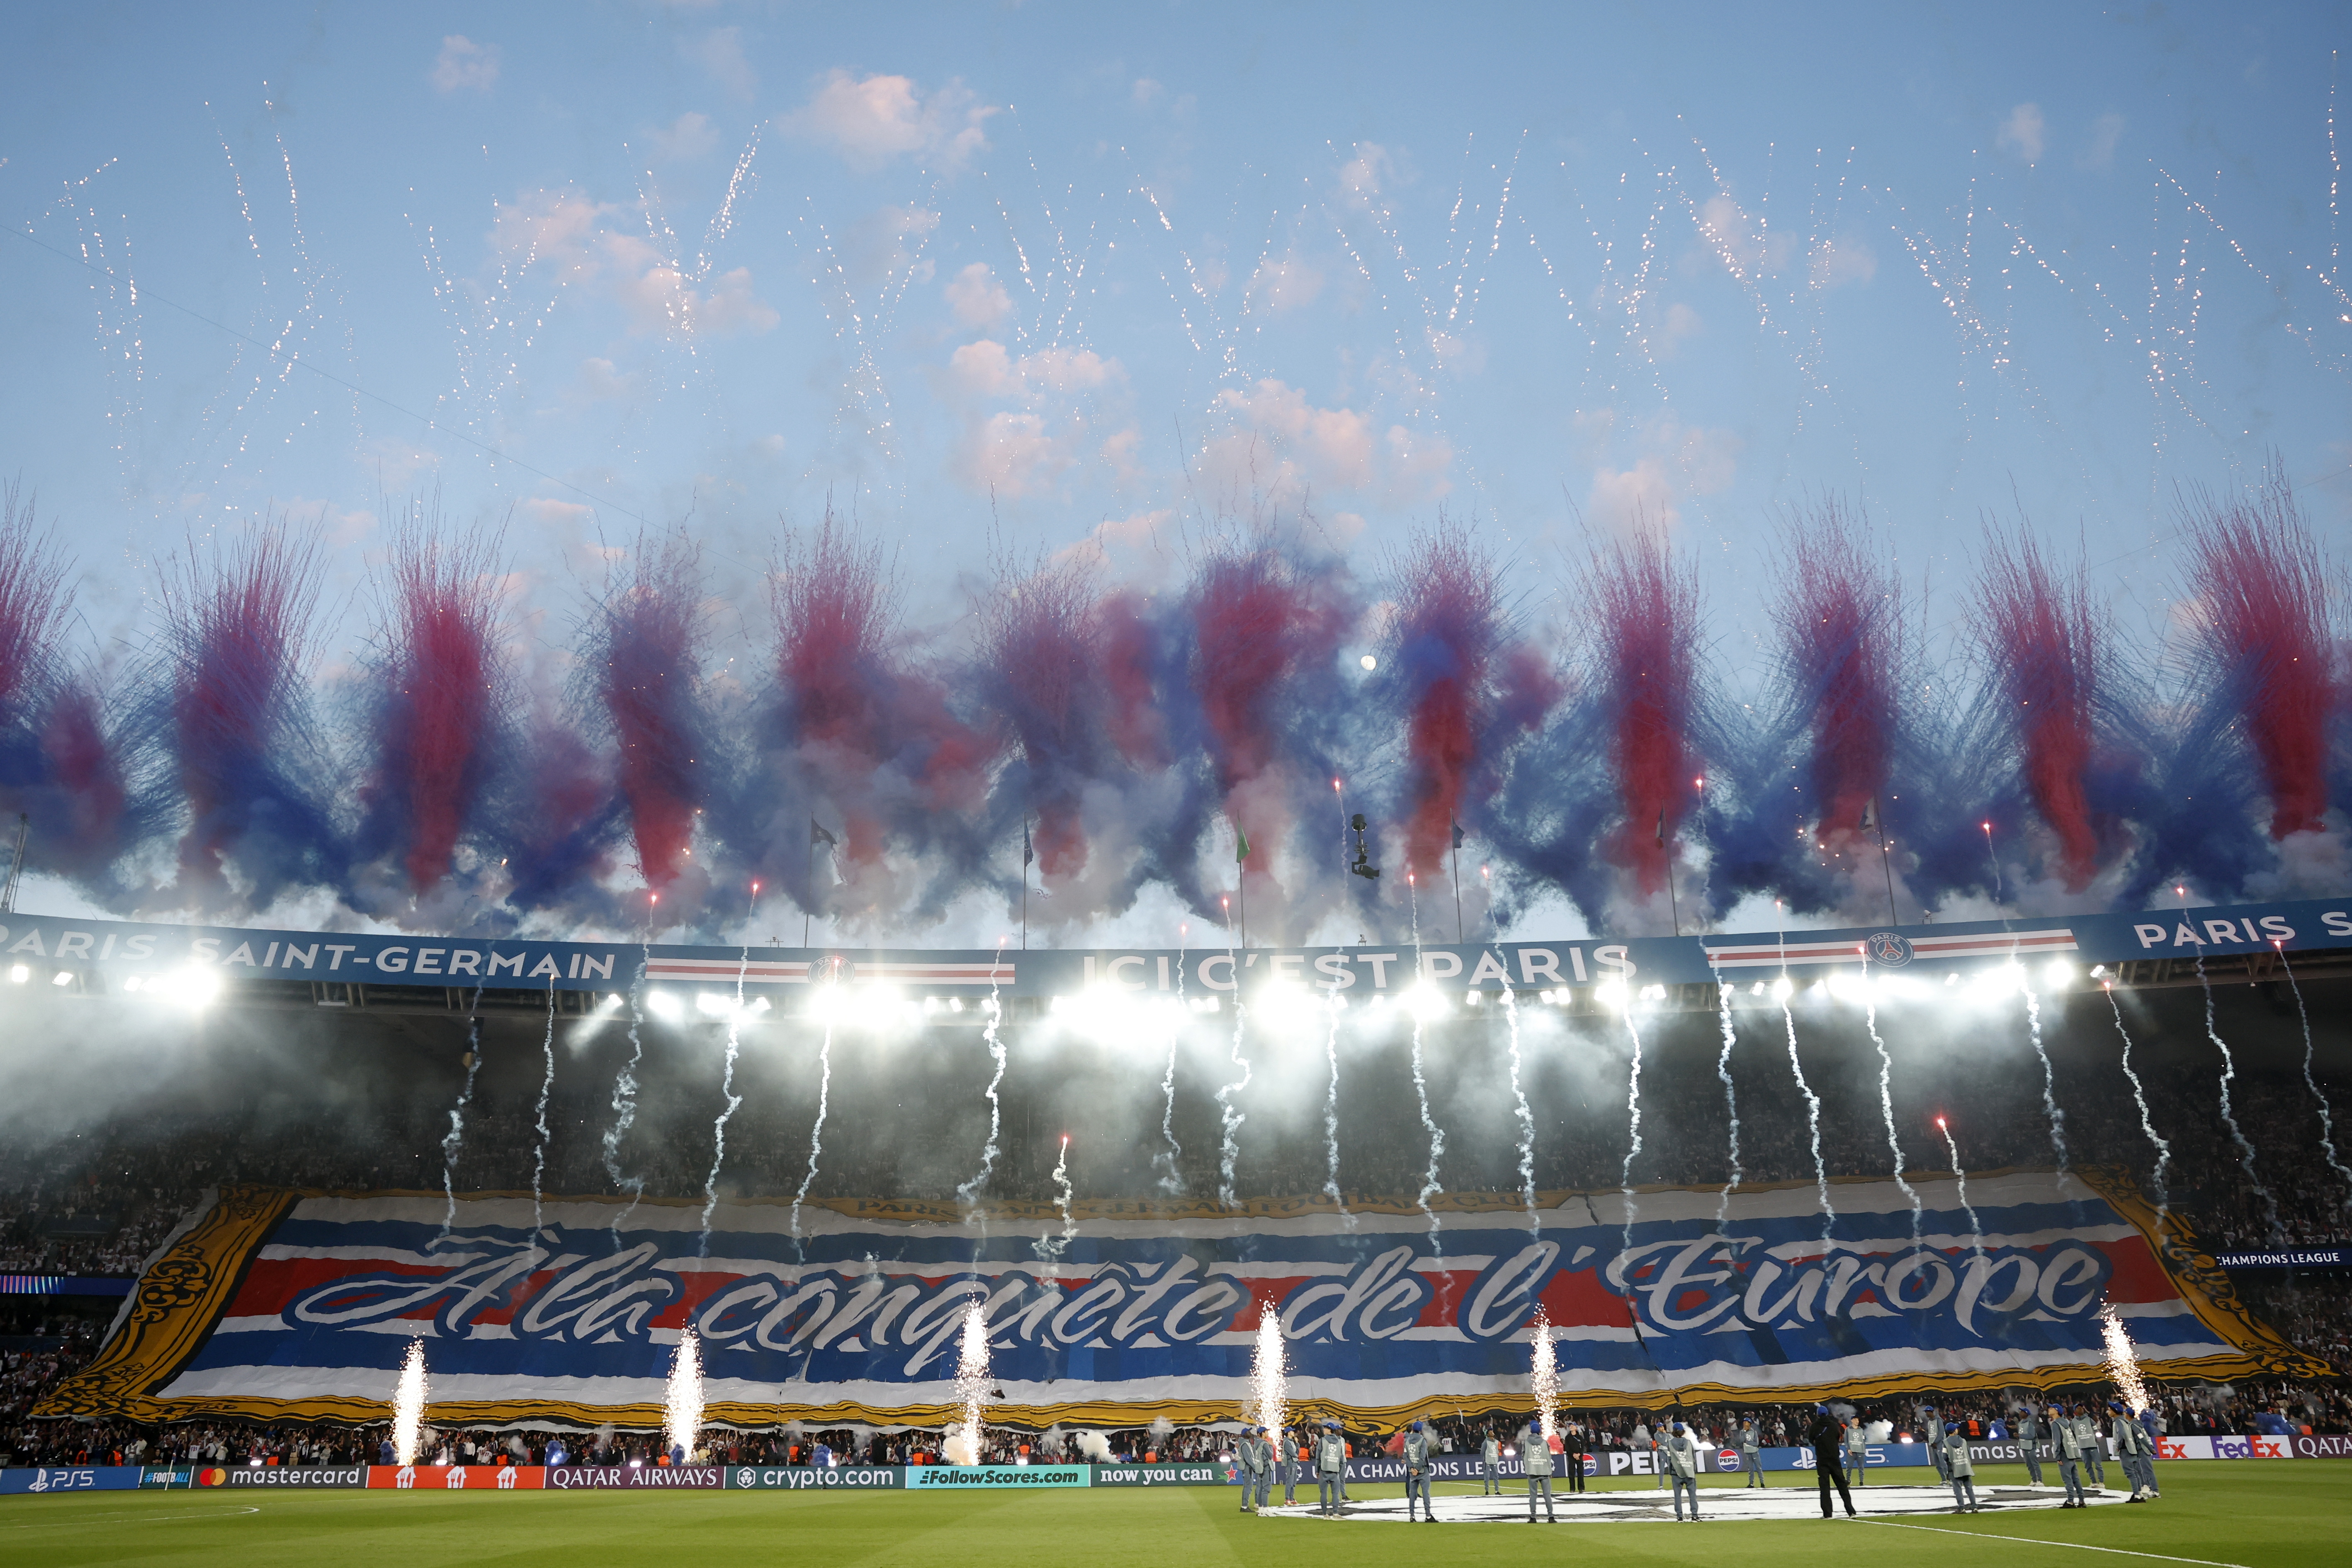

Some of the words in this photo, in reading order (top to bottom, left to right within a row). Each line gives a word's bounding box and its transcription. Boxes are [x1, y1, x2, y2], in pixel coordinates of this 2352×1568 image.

[1871, 934, 1900, 943] PARIS
[2133, 916, 2296, 948] PARIS
[185, 938, 615, 979] SAINT-GERMAIN
[1084, 955, 1170, 992] ICI
[1421, 945, 1637, 986] PARIS
[2291, 1252, 2340, 1263] LEAGUE
[522, 1241, 673, 1339] la
[698, 1254, 1241, 1377] conquête
[1280, 1246, 1422, 1342] de
[2210, 1435, 2284, 1459] FedEx
[232, 1467, 360, 1484] mastercard
[553, 1468, 621, 1489] QATAR
[629, 1468, 717, 1486] AIRWAYS
[763, 1467, 893, 1489] crypto.com
[929, 1470, 1079, 1484] FollowScores.com
[1101, 1469, 1139, 1482] now
[1142, 1468, 1176, 1485] you
[1180, 1468, 1213, 1481] can
[1361, 1461, 1459, 1478] CHAMONS
[1465, 1461, 1526, 1476] LEGUE
[52, 1471, 94, 1488] PS5
